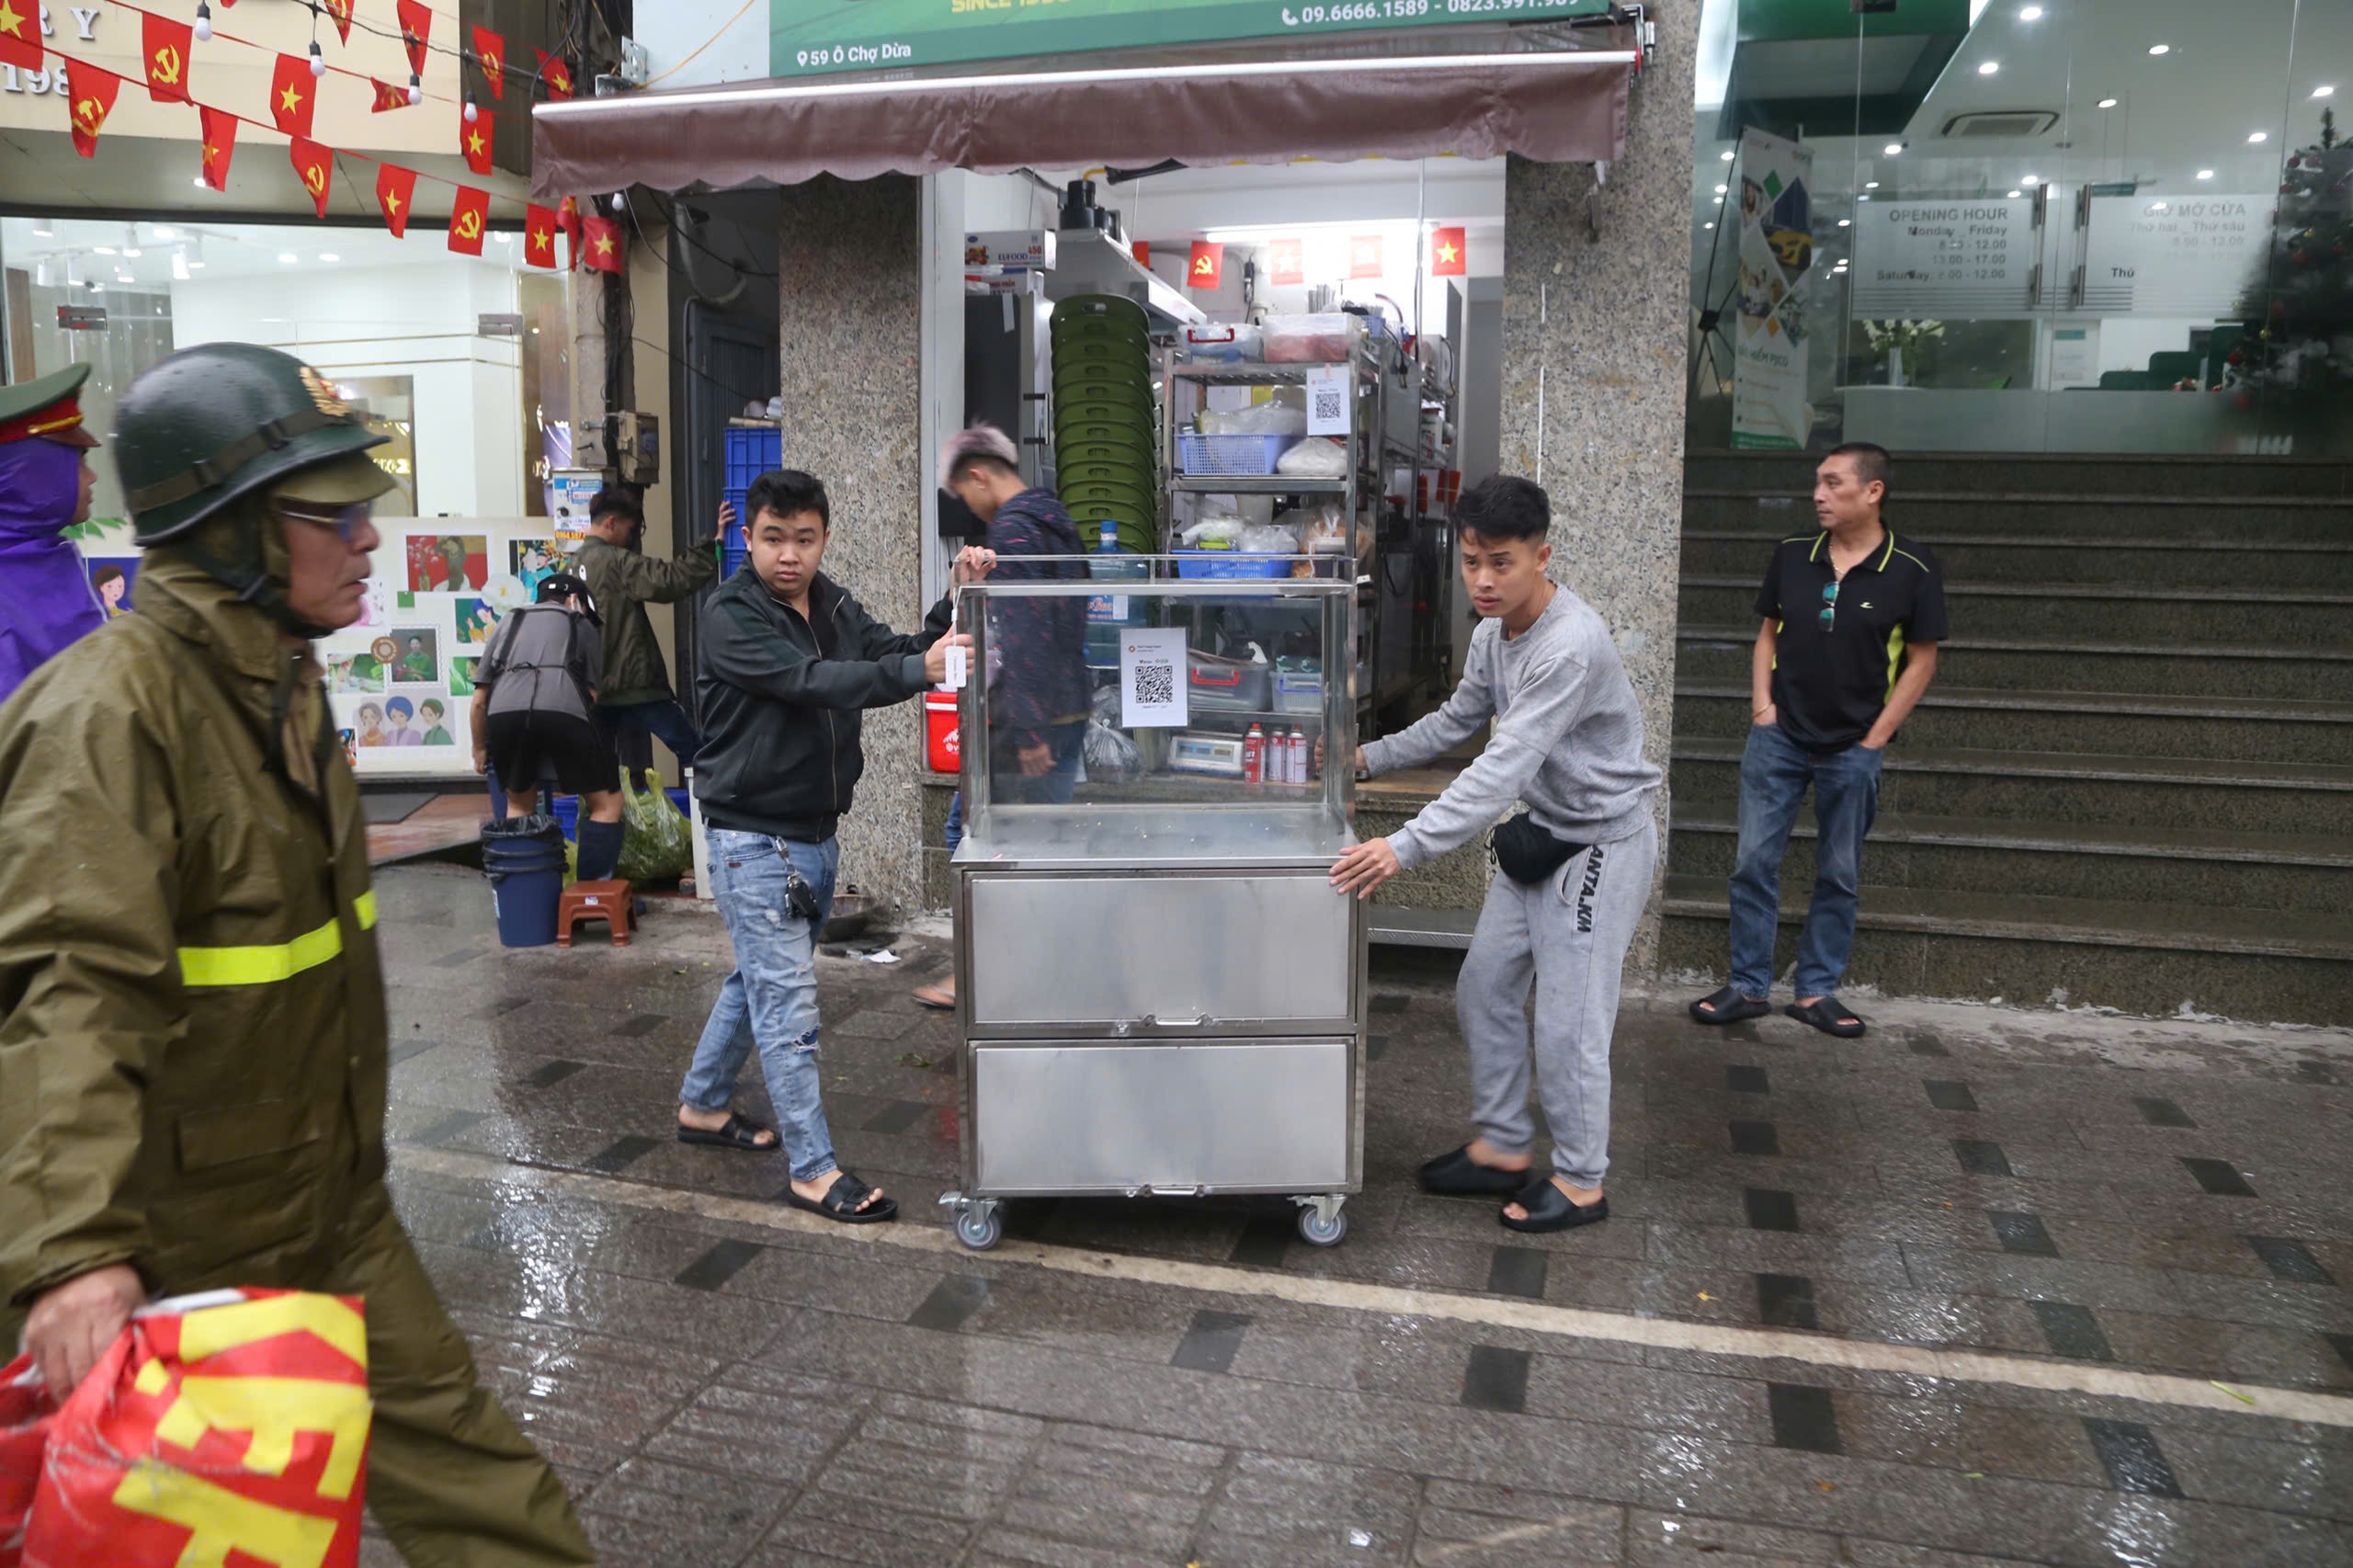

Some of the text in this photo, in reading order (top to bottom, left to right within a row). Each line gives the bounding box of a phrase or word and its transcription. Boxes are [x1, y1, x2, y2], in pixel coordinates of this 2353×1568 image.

[1302, 0, 1427, 23] 09.6666.1589
[811, 42, 911, 65] 59 Ô Chợ Dừa
[3, 61, 70, 97] 198
[1889, 208, 2007, 222] OPENING HOUR
[1908, 225, 1956, 238] Monday
[1969, 224, 2007, 237] Friday
[1975, 239, 2006, 249] 12.00
[1975, 255, 2006, 265] 17.00
[1974, 269, 2006, 279] 12.00
